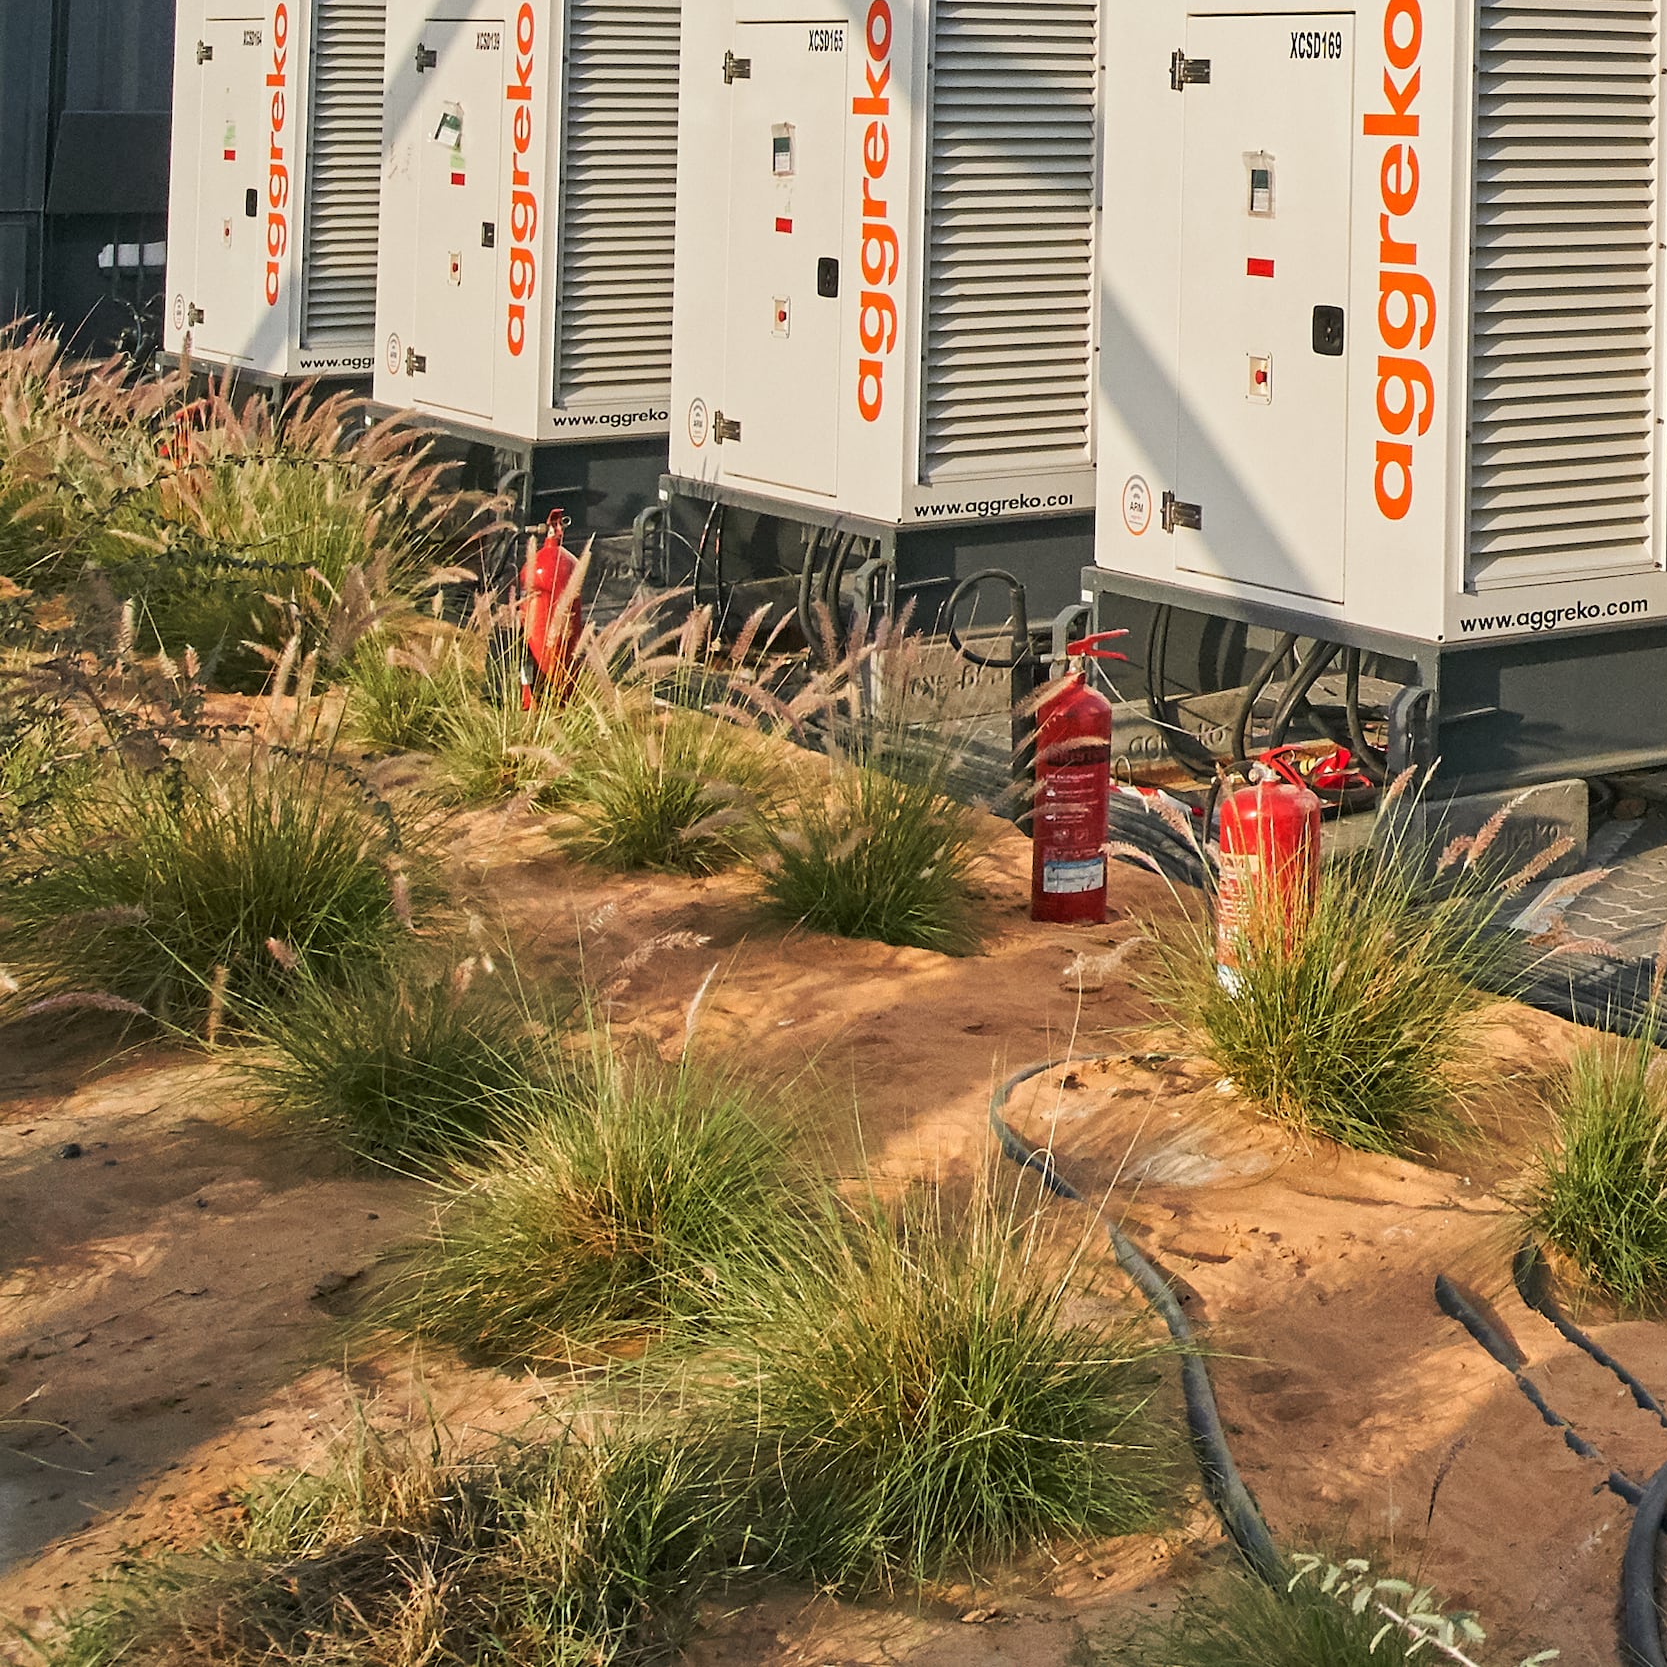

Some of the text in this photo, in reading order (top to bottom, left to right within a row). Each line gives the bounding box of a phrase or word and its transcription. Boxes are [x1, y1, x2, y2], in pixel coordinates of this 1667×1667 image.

[808, 29, 844, 52] XCSD165
[1289, 31, 1342, 60] XCSD169
[266, 4, 290, 307] aggreko
[508, 3, 538, 358] aggreko
[553, 408, 669, 427] www.aggreko
[914, 494, 1073, 517] www.aggreko.co
[1460, 598, 1648, 632] www.aggreko.com
